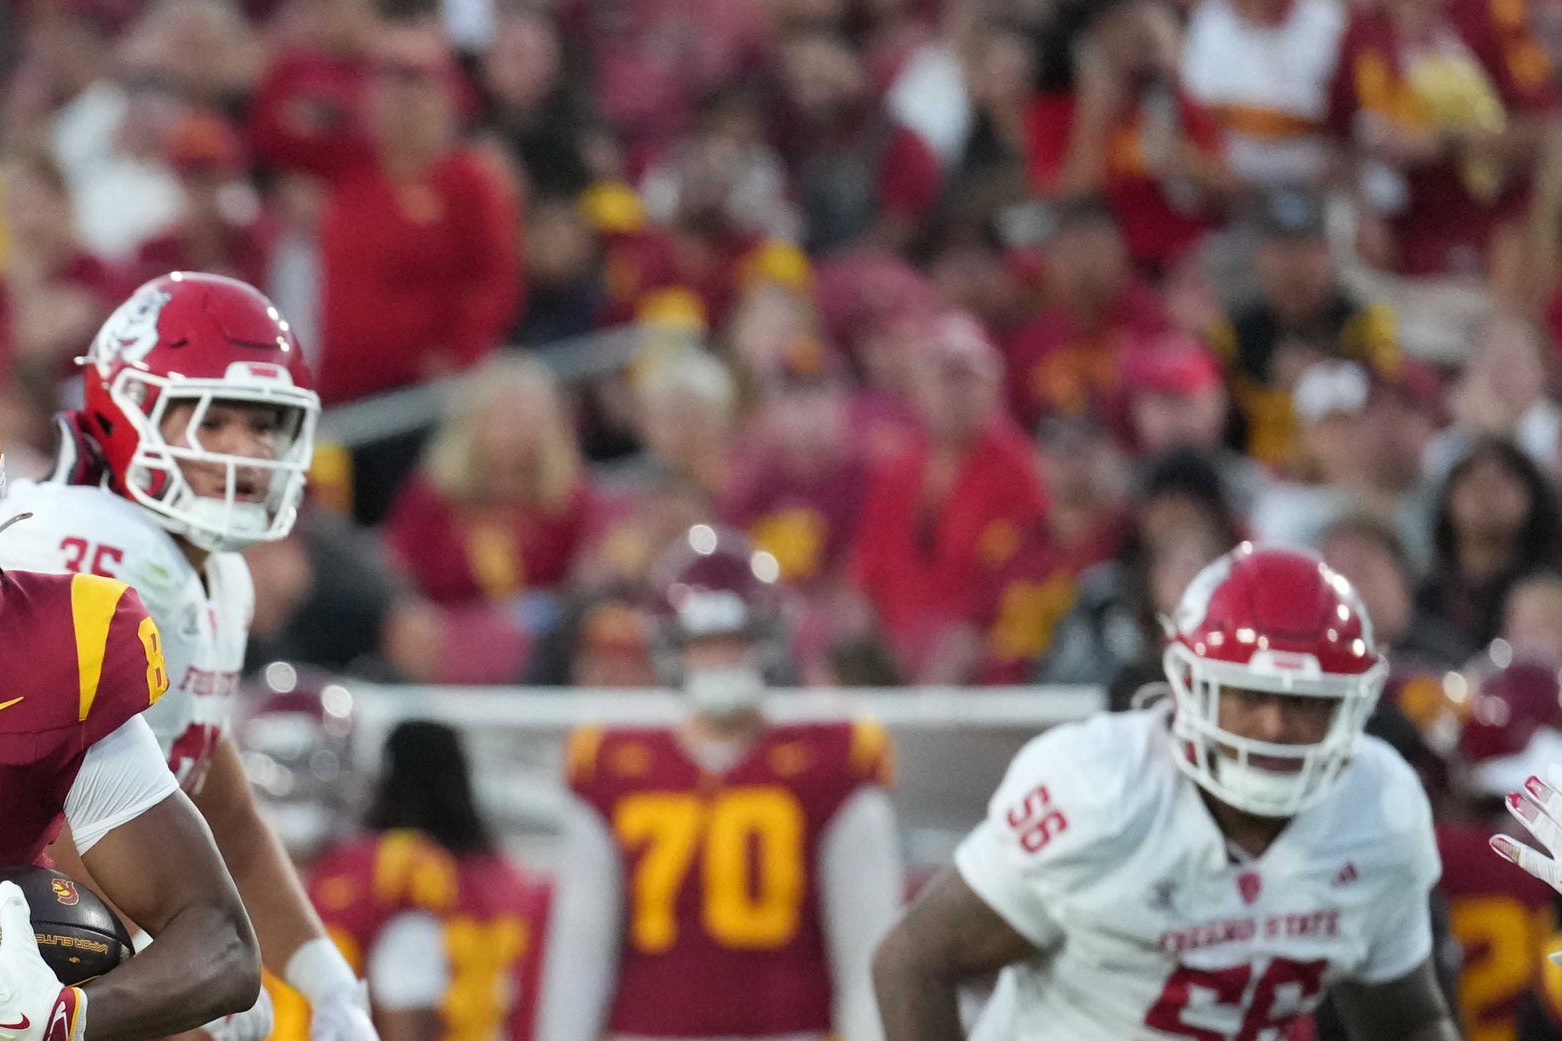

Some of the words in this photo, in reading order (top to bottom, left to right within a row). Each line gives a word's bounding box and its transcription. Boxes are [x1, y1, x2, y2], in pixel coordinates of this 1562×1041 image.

[138, 616, 169, 706] 8
[1007, 784, 1069, 854] 56
[613, 787, 805, 953] 70
[75, 939, 108, 954] VAPOR
